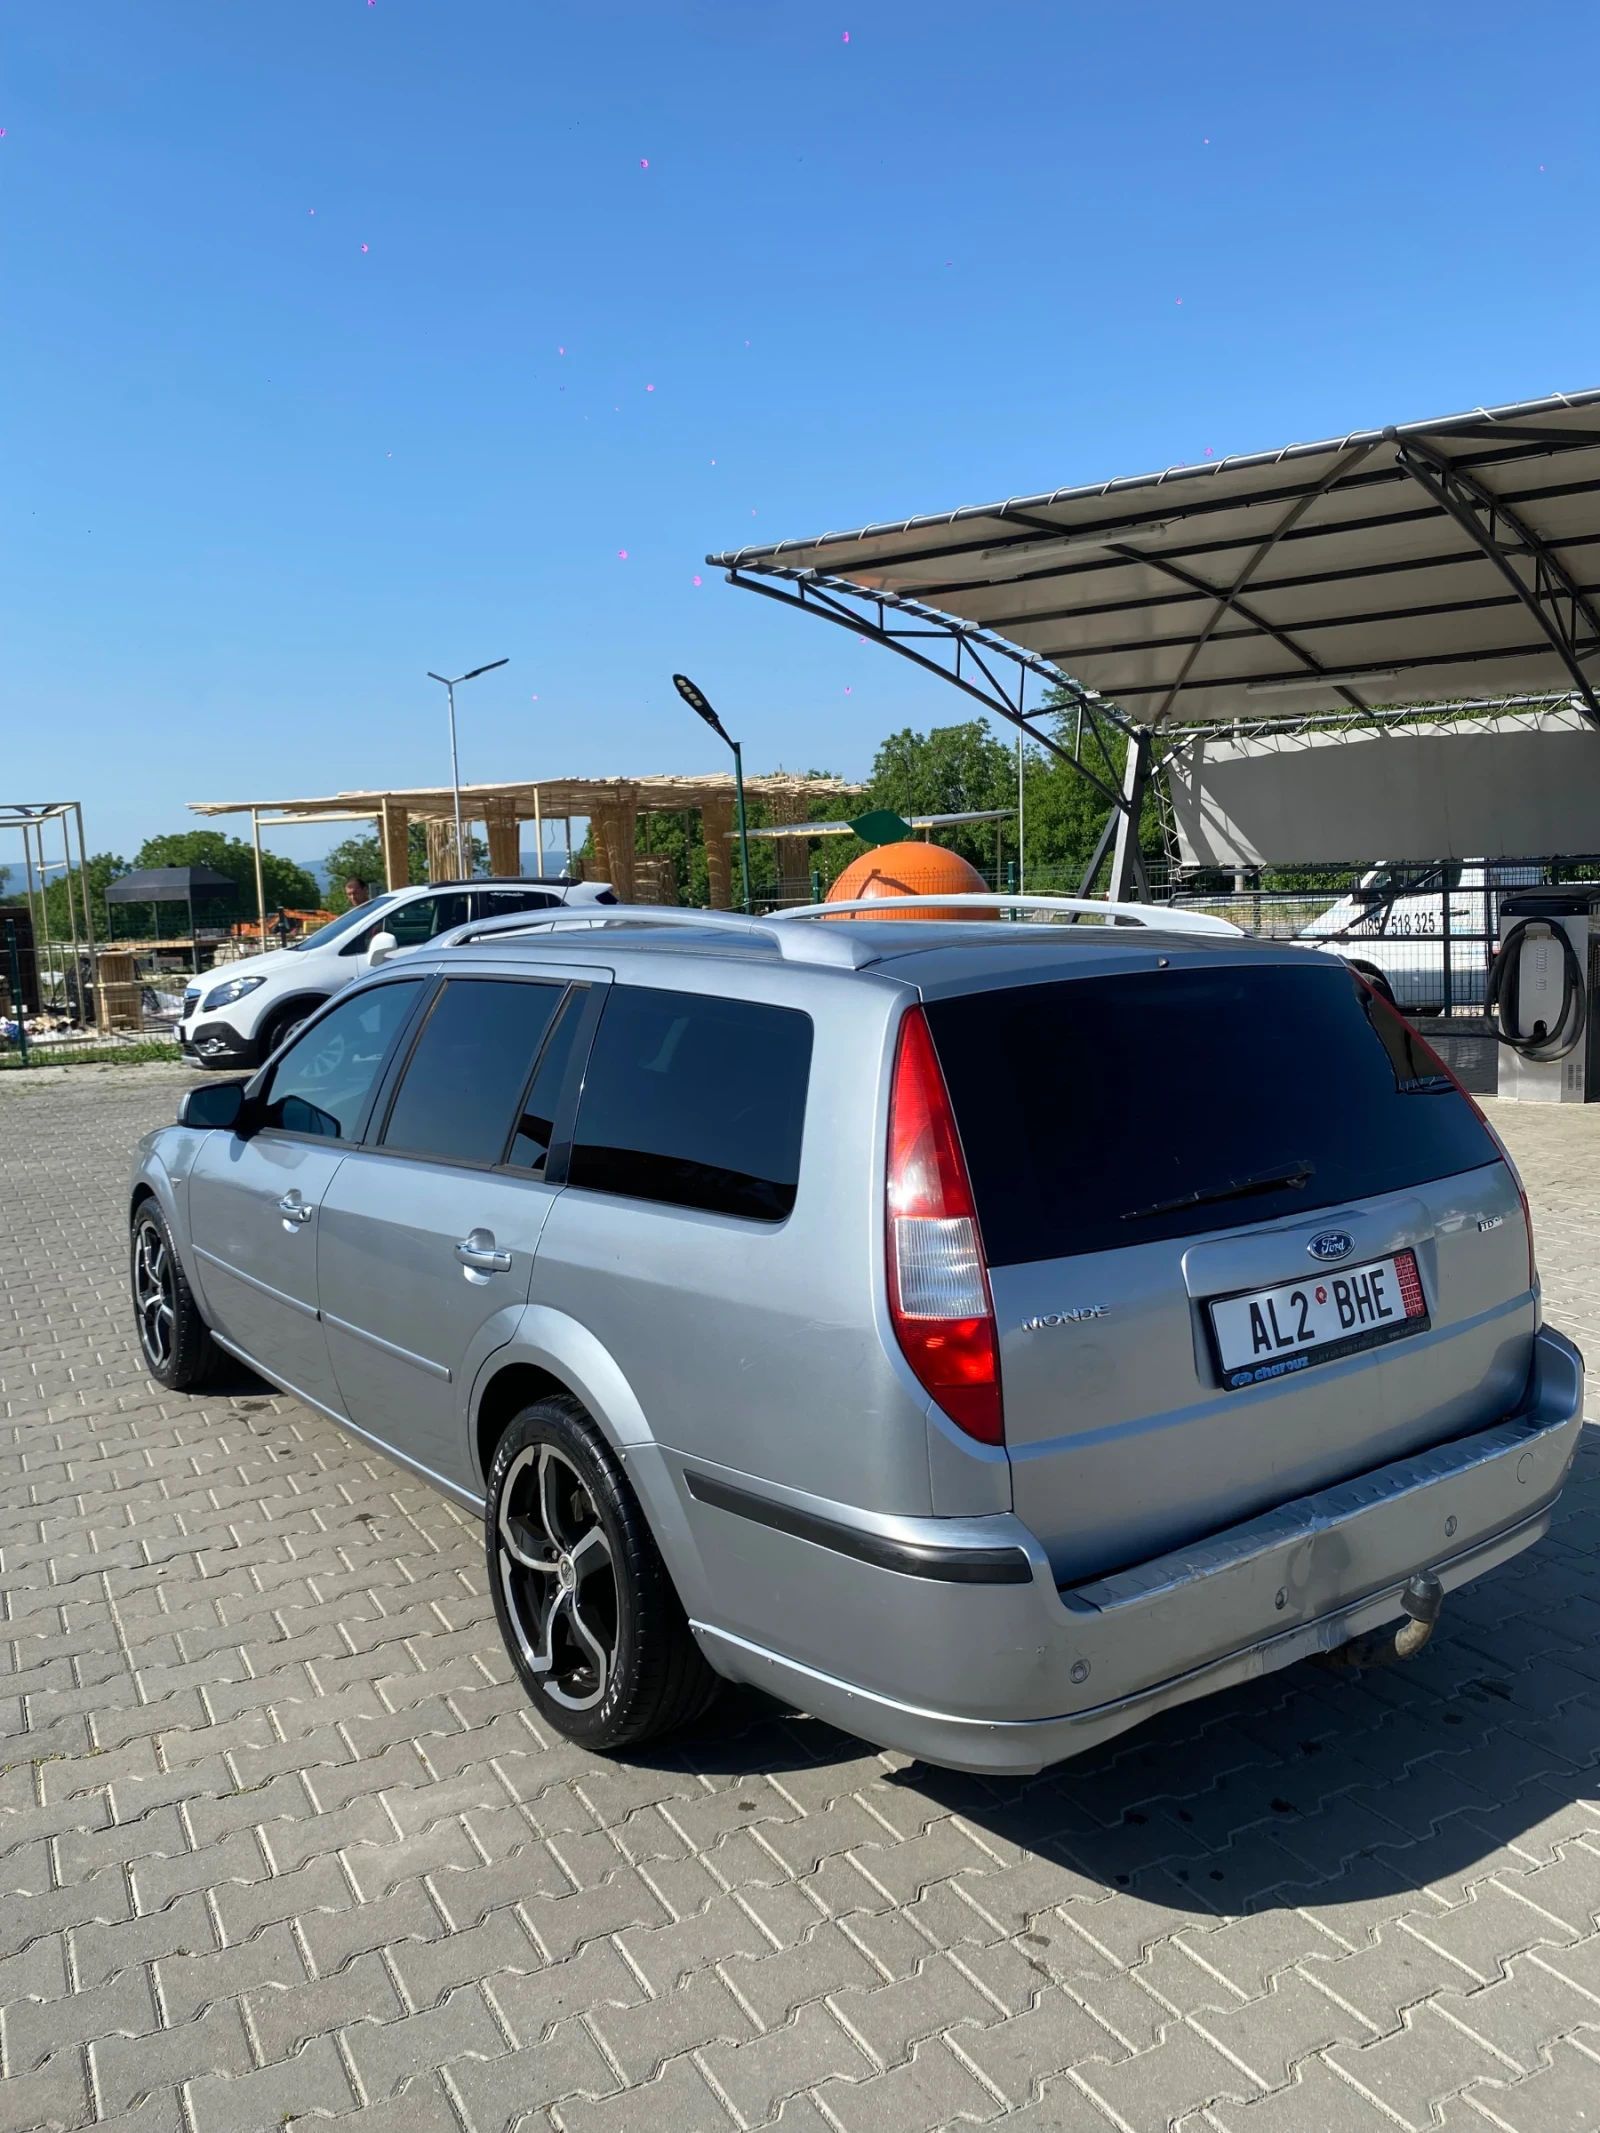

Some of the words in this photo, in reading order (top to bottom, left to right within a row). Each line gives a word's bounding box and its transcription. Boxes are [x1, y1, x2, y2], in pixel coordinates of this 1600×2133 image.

[1391, 914, 1411, 935] 518
[1414, 912, 1435, 934] 325
[1321, 1236, 1345, 1253] Ford
[1021, 1303, 1111, 1332] MONDE
[1249, 1290, 1315, 1354] AL2
[1332, 1268, 1393, 1329] BHE
[1254, 1356, 1309, 1381] charouz
